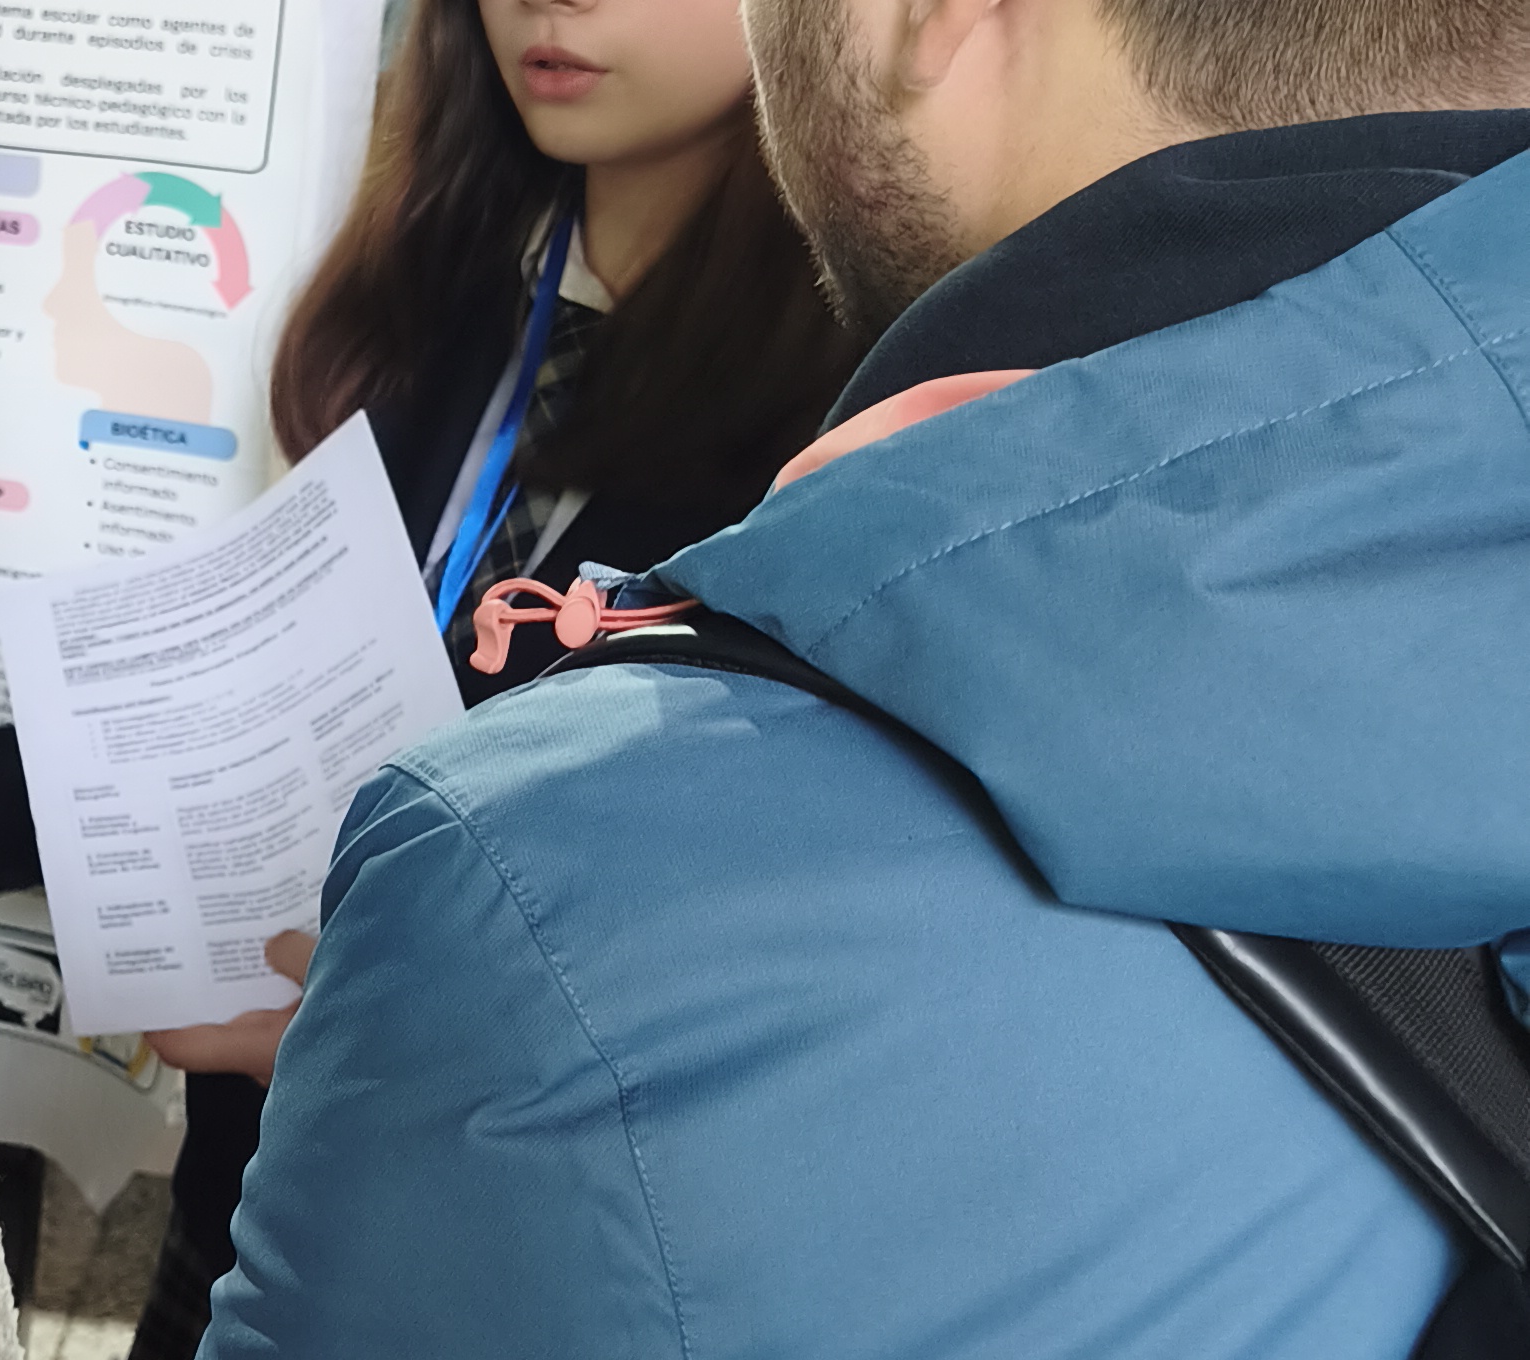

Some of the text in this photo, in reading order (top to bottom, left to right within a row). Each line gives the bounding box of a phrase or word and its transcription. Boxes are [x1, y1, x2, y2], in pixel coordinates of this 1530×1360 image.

[125, 220, 195, 241] ESTUDIO
[106, 242, 210, 267] CUALITATIVO
[111, 422, 187, 446] BIOÉTICA
